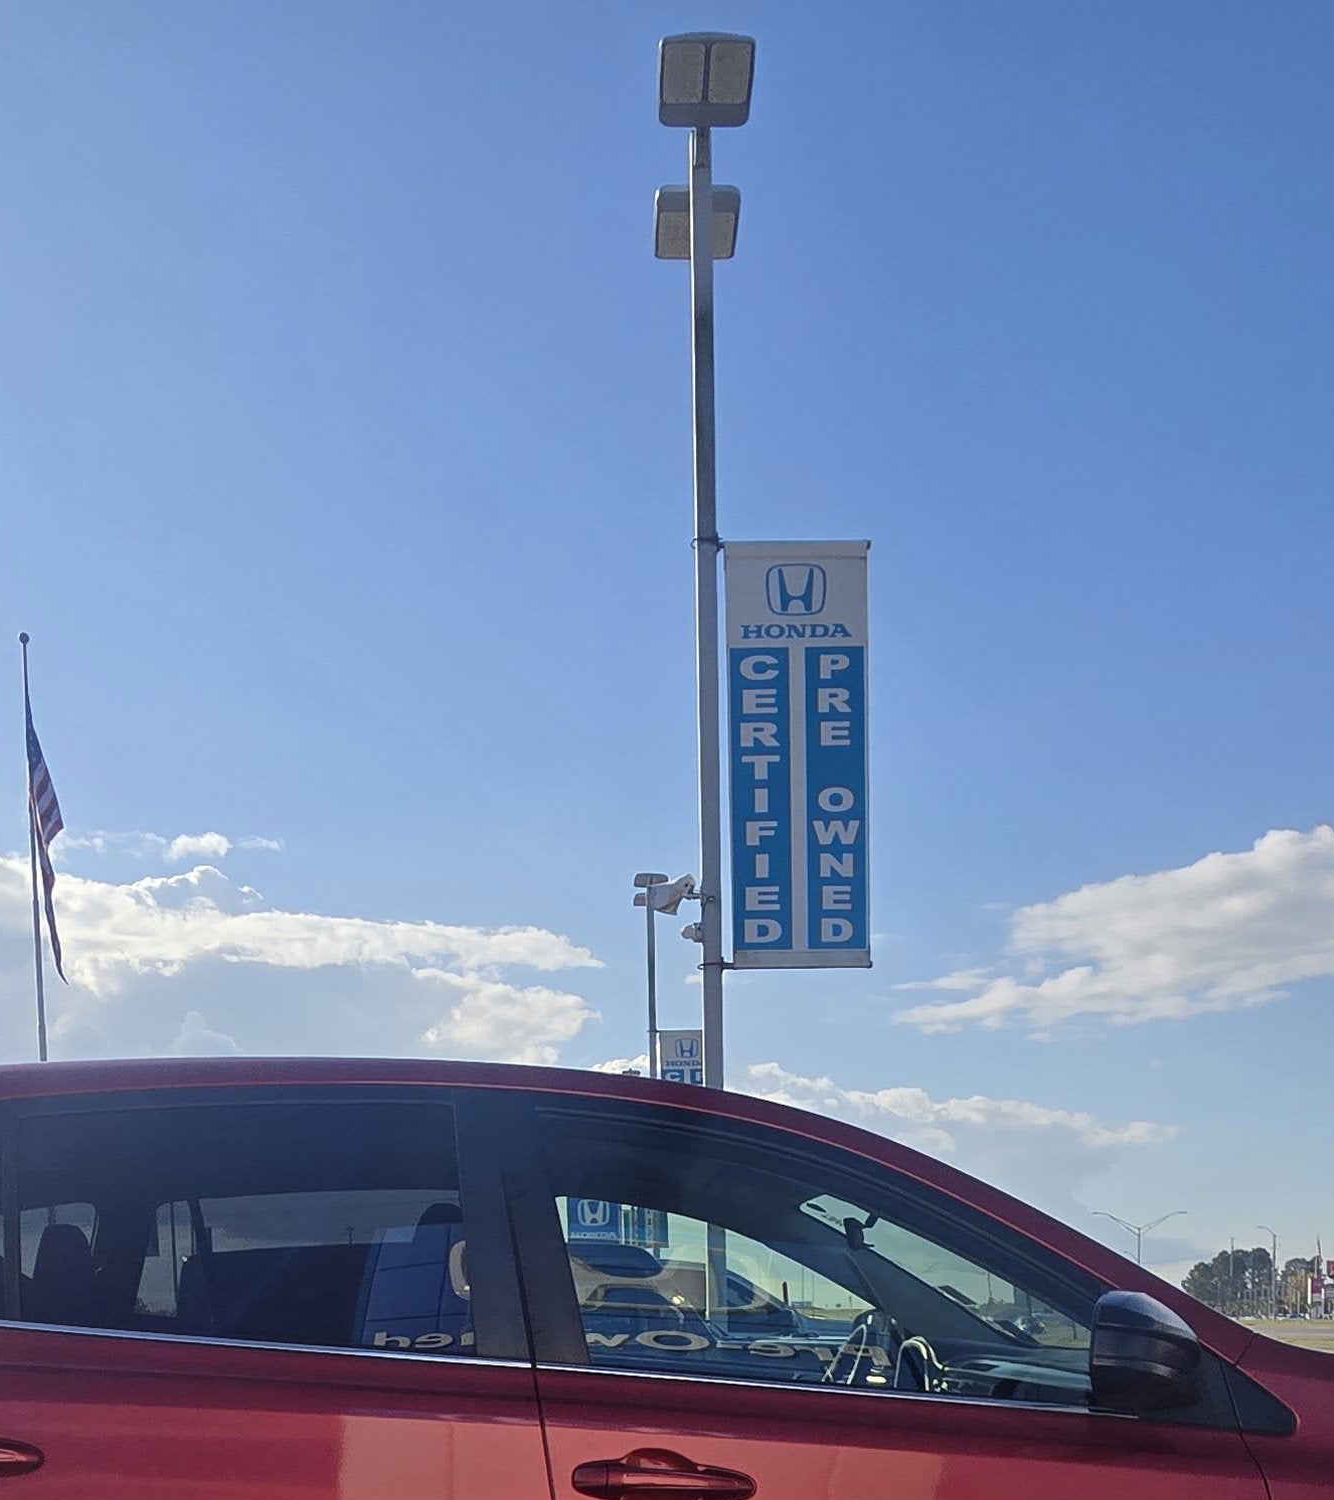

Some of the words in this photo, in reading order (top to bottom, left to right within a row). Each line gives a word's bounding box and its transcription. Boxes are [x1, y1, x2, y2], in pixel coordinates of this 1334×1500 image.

[740, 623, 852, 640] HONDA
[818, 653, 851, 747] PRE
[739, 654, 783, 945] CERTIFIED
[812, 786, 861, 944] OWNED
